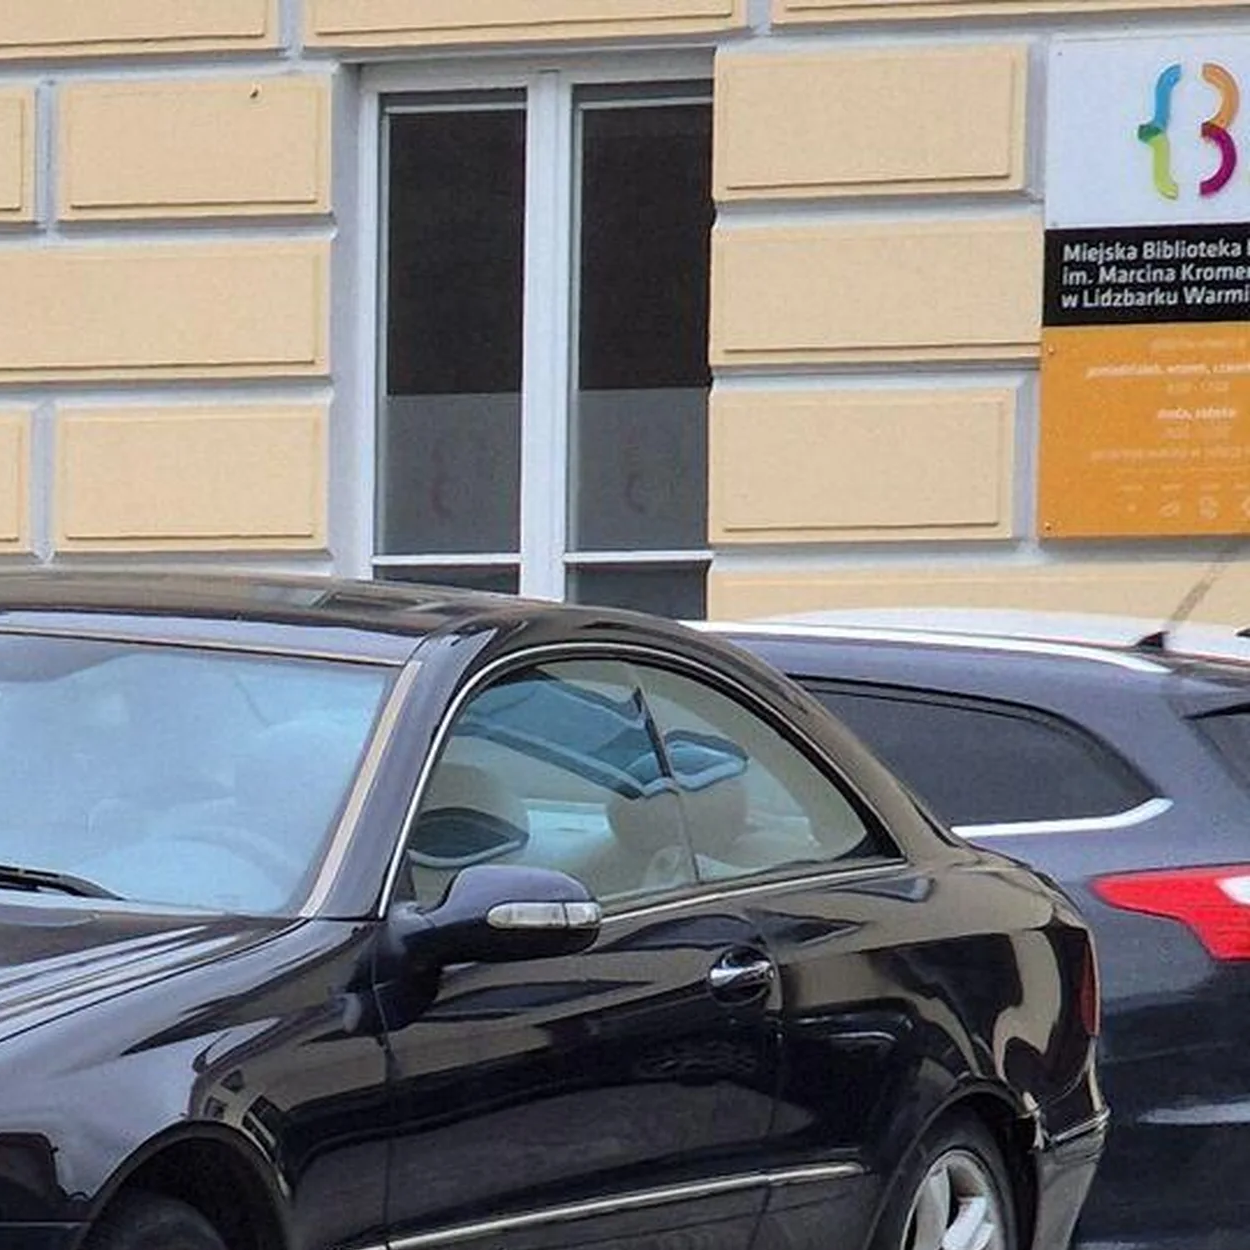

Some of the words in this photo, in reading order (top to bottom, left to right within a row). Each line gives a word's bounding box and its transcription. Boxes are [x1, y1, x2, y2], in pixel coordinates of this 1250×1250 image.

[1063, 241, 1138, 265] Miejska
[1143, 238, 1242, 260] Biblioteka
[1062, 266, 1094, 285] im.
[1098, 264, 1177, 284] Marcina
[1061, 293, 1079, 308] w
[1083, 288, 1179, 308] Lidzbarku
